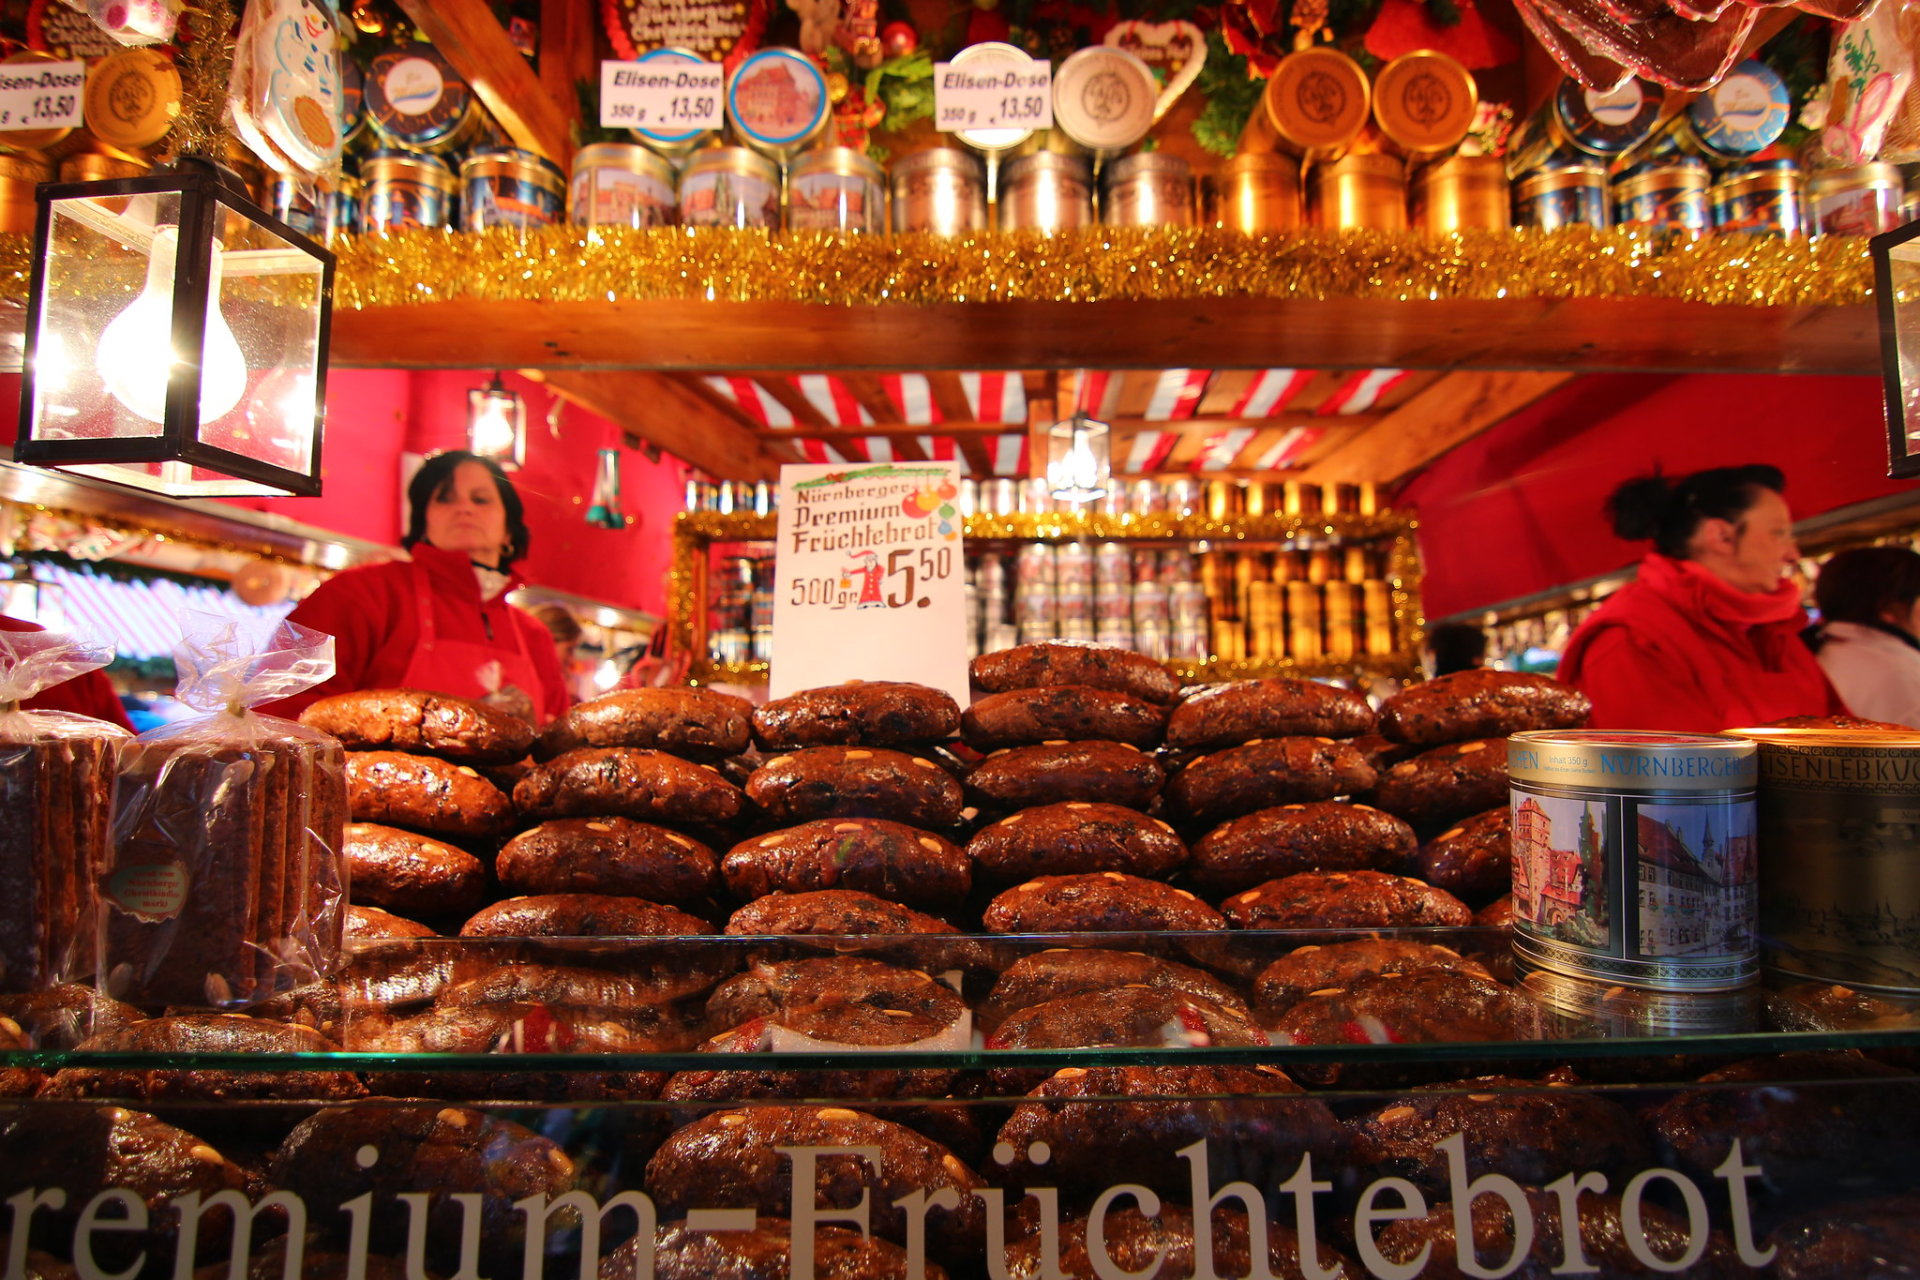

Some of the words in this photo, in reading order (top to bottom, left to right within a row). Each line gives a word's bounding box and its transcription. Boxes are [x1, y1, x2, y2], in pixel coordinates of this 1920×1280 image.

[613, 71, 721, 88] Elisen-Dose
[943, 72, 1048, 89] Elisen-Dose
[33, 95, 75, 122] 13,50
[610, 105, 636, 118] 350
[672, 97, 714, 121] 13,50
[943, 108, 965, 121] 350
[1000, 97, 1043, 118] 13,50
[797, 484, 910, 504] Nürnberger
[792, 503, 900, 528] Premium
[791, 517, 937, 554] Früchtebrot
